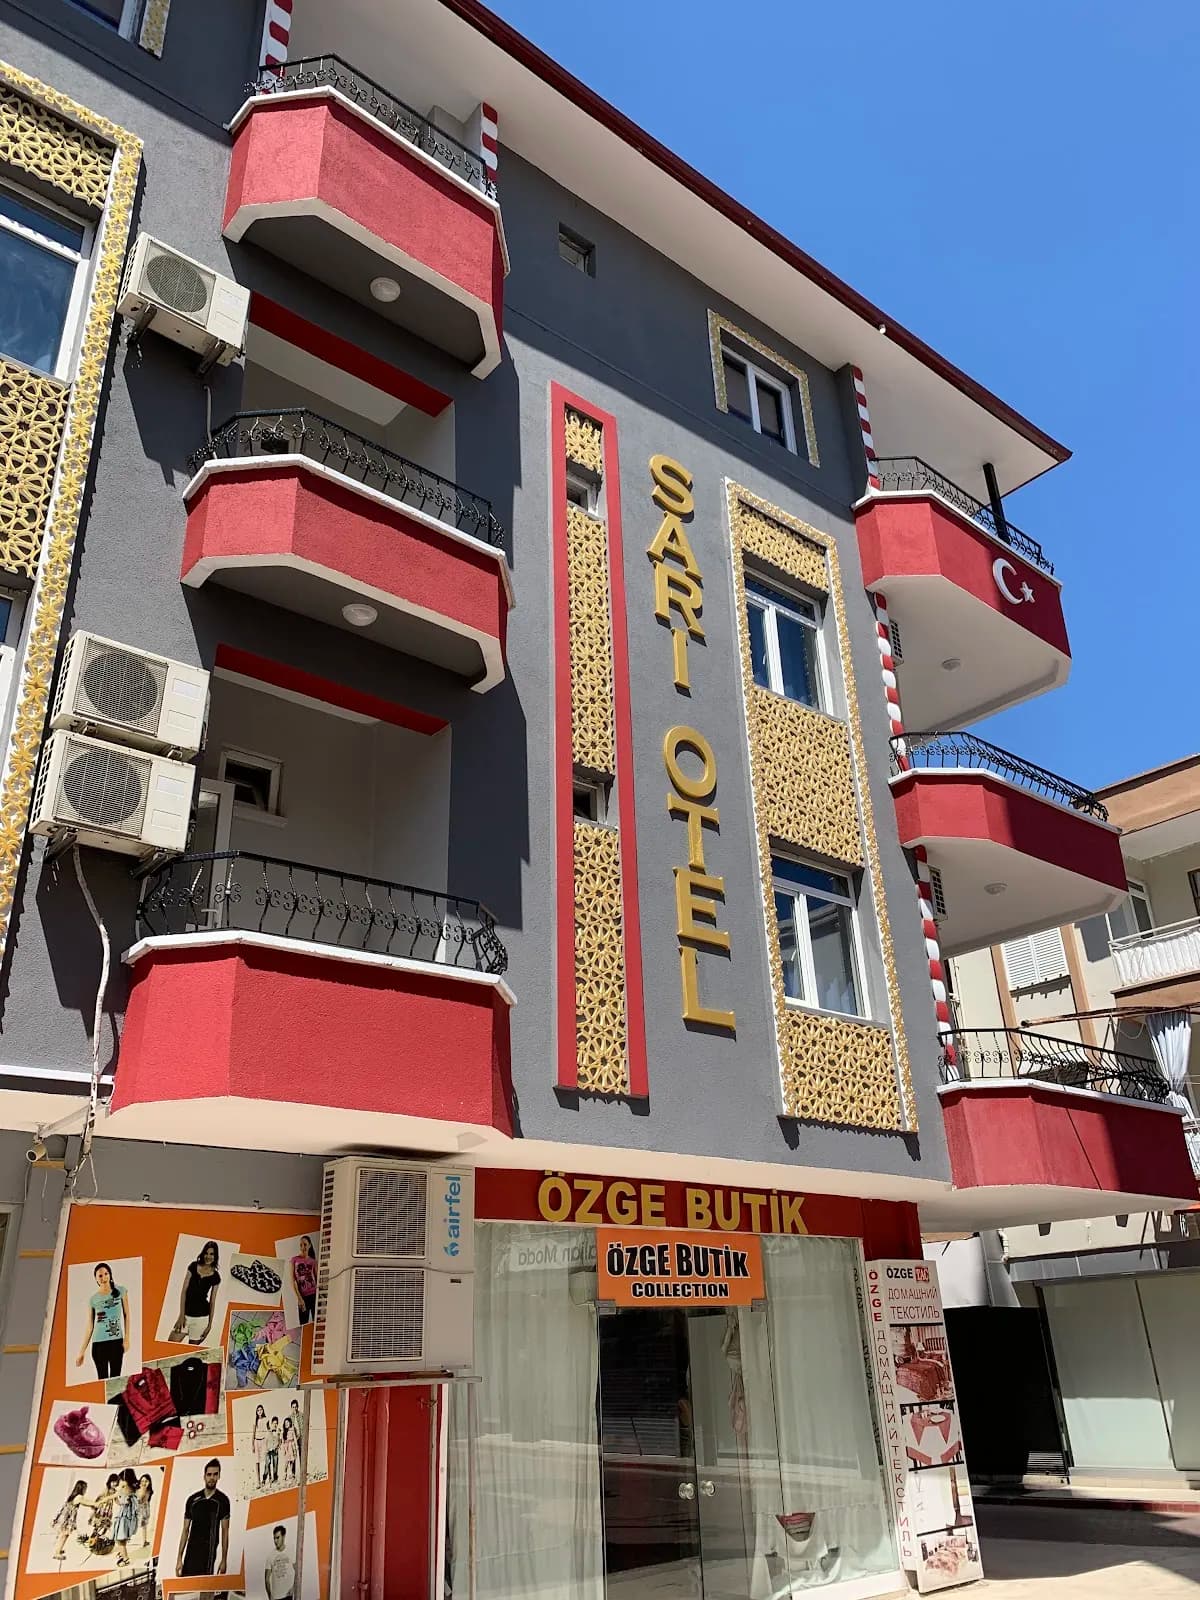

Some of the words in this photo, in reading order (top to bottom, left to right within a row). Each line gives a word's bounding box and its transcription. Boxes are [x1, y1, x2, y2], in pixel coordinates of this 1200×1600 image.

[648, 454, 704, 688] SARI
[663, 725, 736, 1032] OTEL
[445, 1176, 461, 1237] airfel
[538, 1169, 666, 1227] ÖZGE
[686, 1187, 809, 1235] BUTİK
[607, 1241, 671, 1277] ÖZGE
[675, 1242, 750, 1278] BUTİK
[632, 1282, 729, 1298] COLLECTION
[869, 1268, 882, 1322] ÖZGE
[890, 1305, 940, 1320] ТЕКСТИЛЬ
